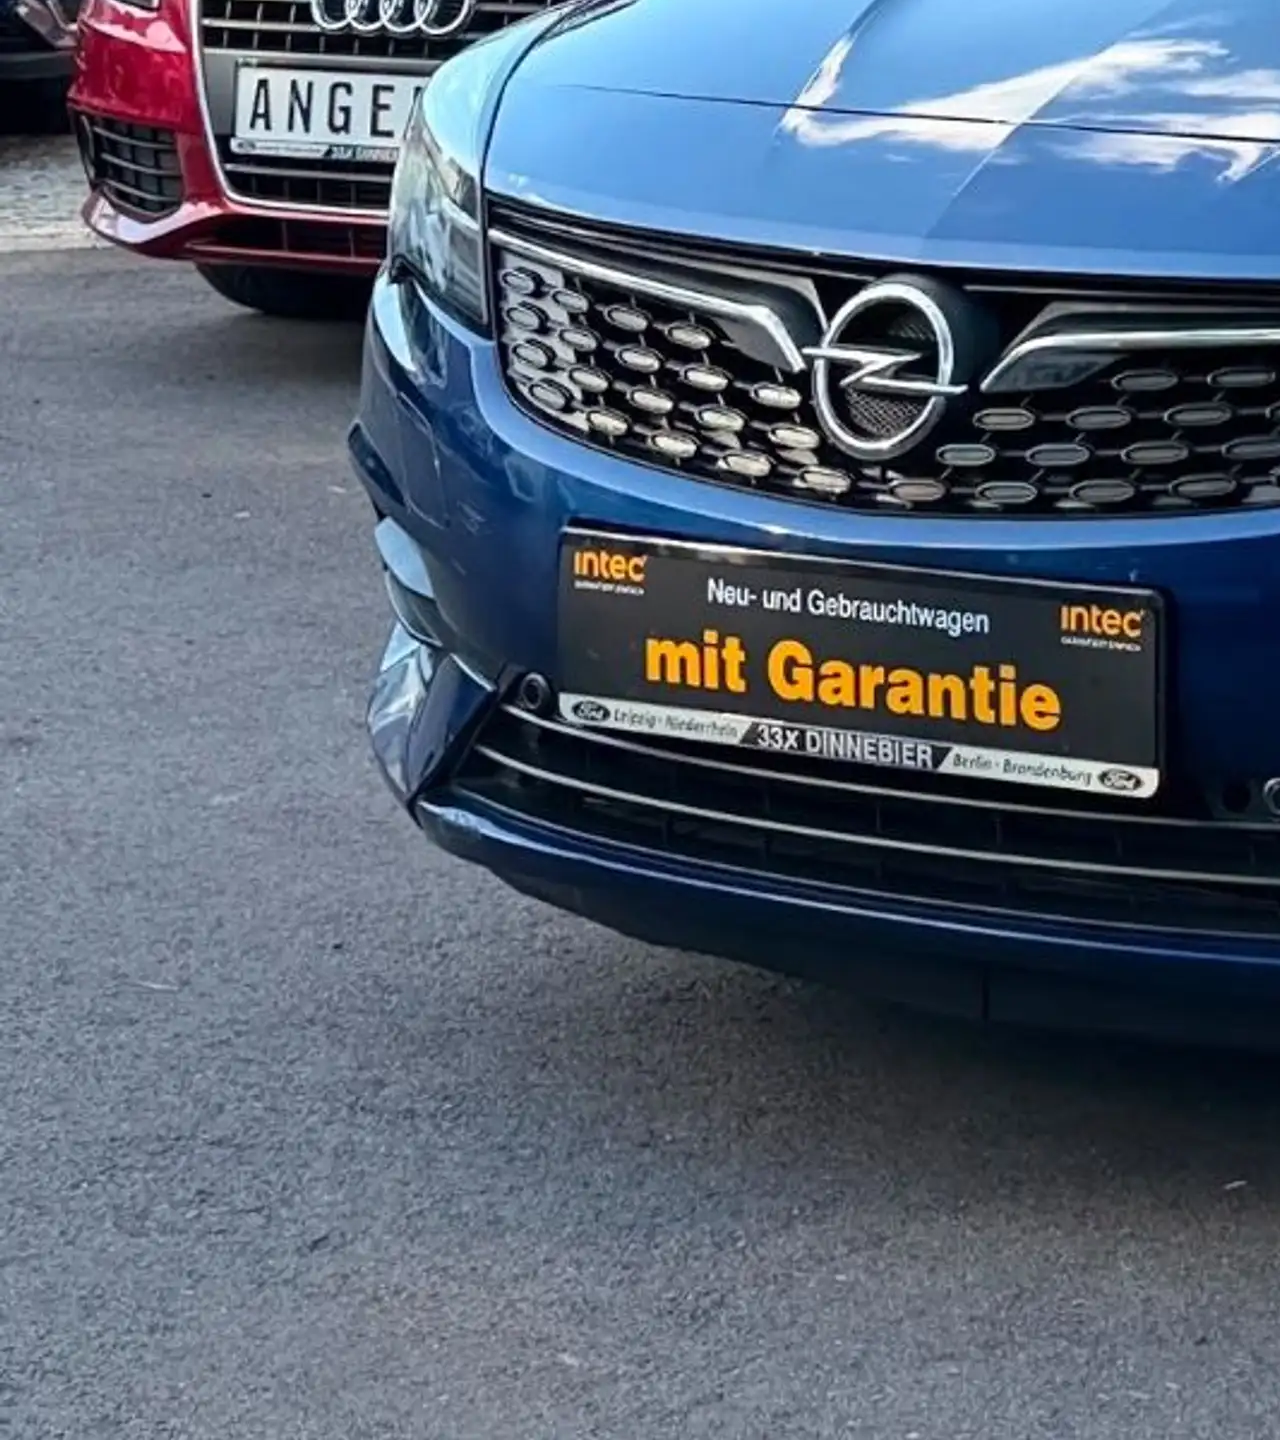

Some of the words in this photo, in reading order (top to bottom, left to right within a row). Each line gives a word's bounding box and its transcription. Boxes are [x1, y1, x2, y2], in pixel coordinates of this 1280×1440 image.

[250, 78, 423, 139] ANGE
[707, 577, 756, 607] Neu-
[762, 588, 801, 613] und
[807, 591, 990, 638] Gebrauchtwagen
[646, 629, 746, 693] mit
[768, 639, 1062, 731] Garantie
[613, 708, 656, 730] Leipzig
[757, 723, 800, 751] 33X
[805, 728, 933, 771] DINNEBIER
[953, 752, 991, 769] Berlin
[1003, 758, 1092, 787] Brandenburg
